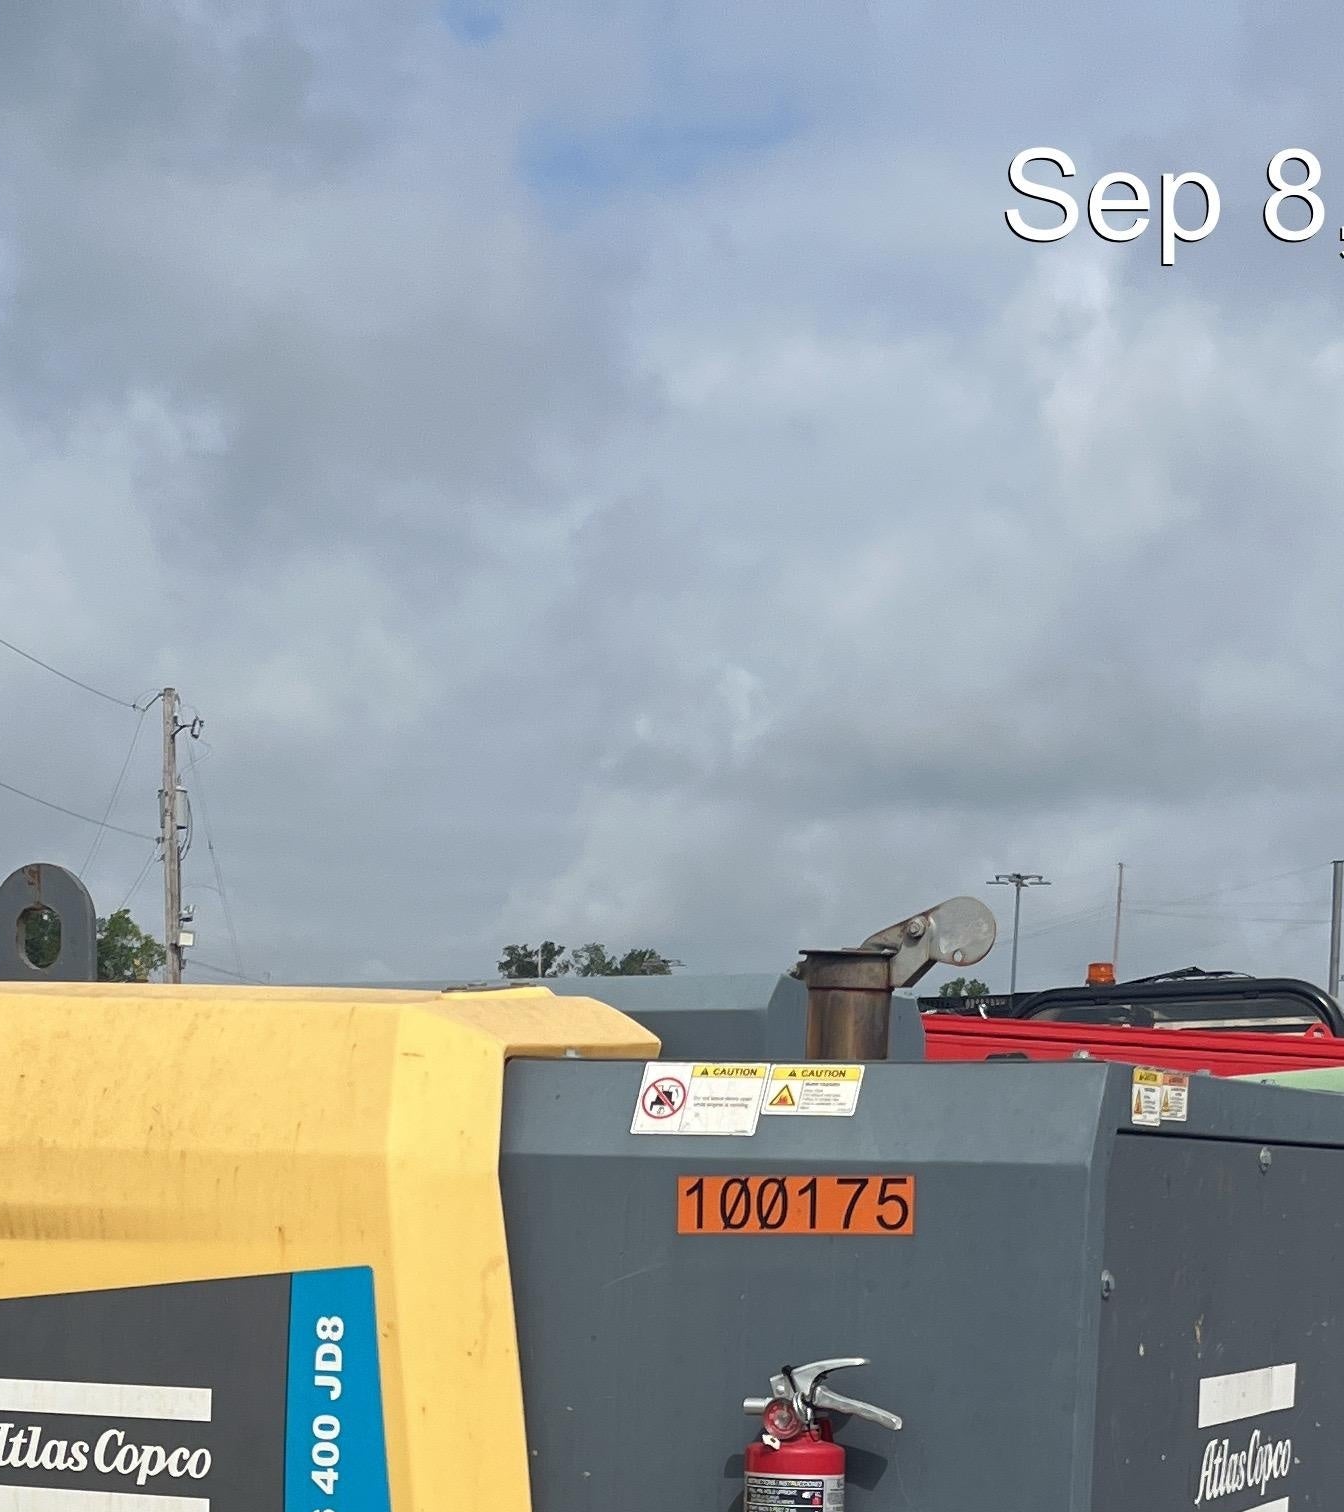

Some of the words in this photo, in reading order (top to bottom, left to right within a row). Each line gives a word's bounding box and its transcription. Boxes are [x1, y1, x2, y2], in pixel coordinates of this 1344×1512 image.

[712, 1068, 758, 1076] CAUTION
[801, 1069, 847, 1078] CAUTION
[685, 1176, 909, 1231] 100175
[314, 1315, 345, 1401] JD8
[92, 1429, 212, 1485] Copco
[310, 1414, 341, 1495] 400
[1194, 1438, 1246, 1506] Atlas
[1246, 1429, 1292, 1497] Copco
